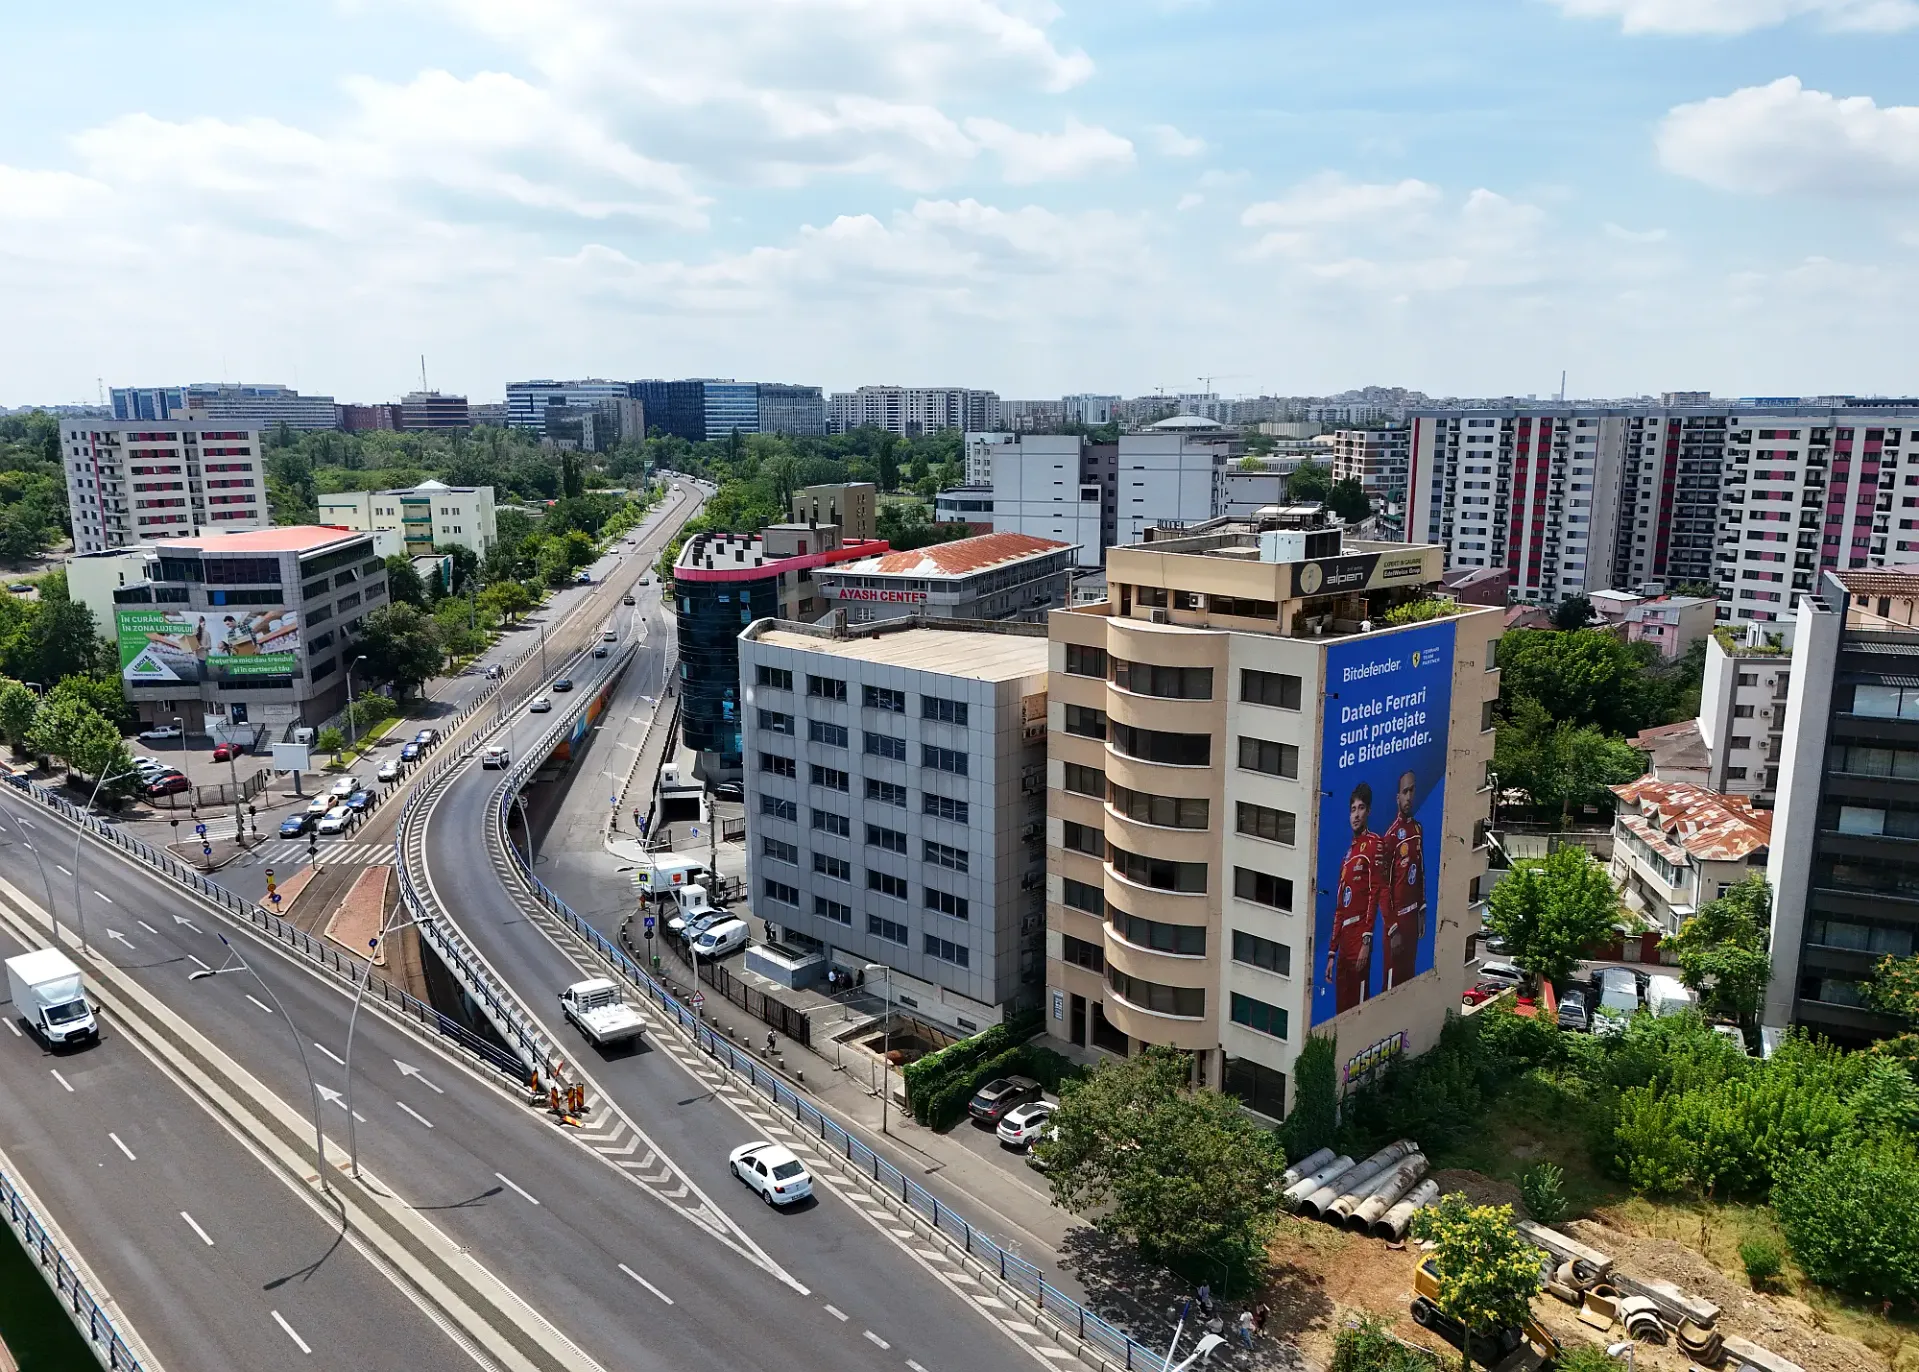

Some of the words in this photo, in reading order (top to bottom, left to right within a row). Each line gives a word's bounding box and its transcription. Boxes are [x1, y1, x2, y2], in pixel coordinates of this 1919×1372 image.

[1327, 565, 1363, 585] alpen
[839, 588, 877, 600] AYASH
[132, 658, 146, 672] LEROY
[144, 655, 162, 672] MERLIN
[1341, 699, 1383, 724] Datele
[1385, 686, 1426, 712] Ferrari
[1340, 725, 1368, 746] sunt
[1371, 710, 1426, 742] protejate
[1338, 750, 1355, 768] de
[1358, 730, 1432, 763] Bitdefender.
